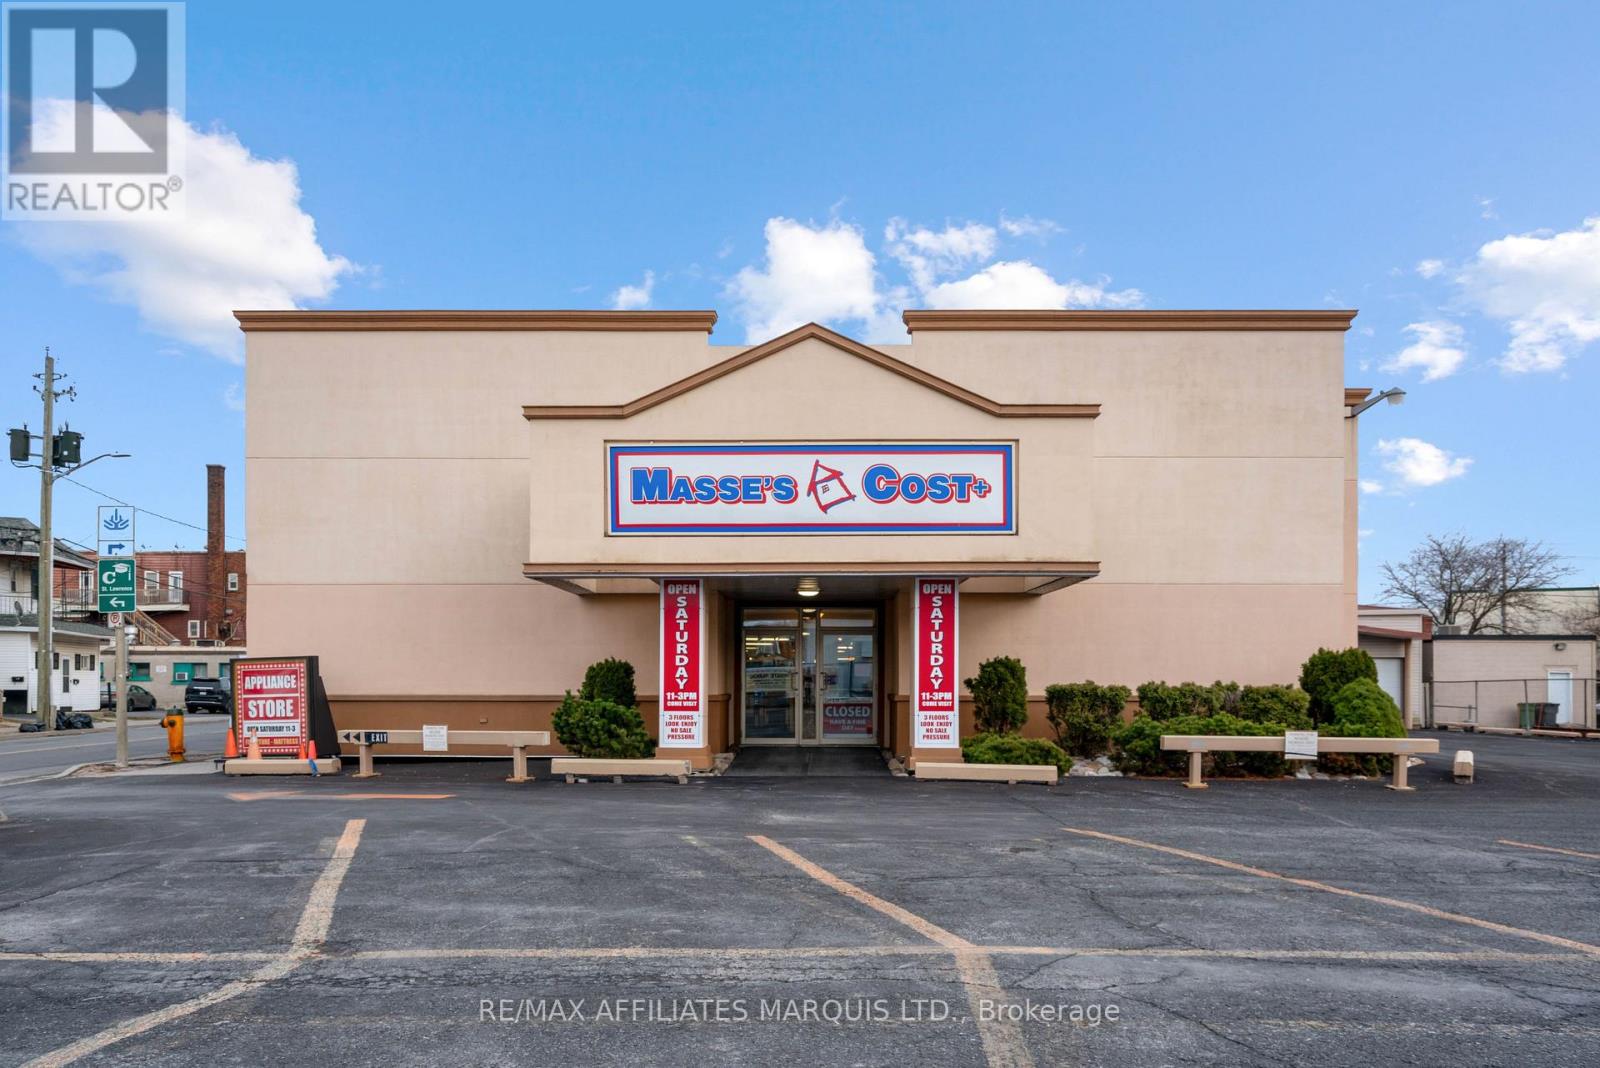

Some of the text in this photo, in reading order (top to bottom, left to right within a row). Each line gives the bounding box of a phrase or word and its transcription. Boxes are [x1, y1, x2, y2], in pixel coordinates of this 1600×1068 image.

[630, 467, 798, 504] MASSE'S
[667, 584, 697, 595] OPEN
[922, 584, 952, 595] OPEN
[675, 596, 689, 690] SATURDAY
[930, 596, 944, 690] SATURDAY
[244, 675, 297, 690] APPLIANCE
[665, 692, 697, 700] 11-3PM
[920, 692, 952, 700] 11-3PM
[248, 699, 294, 718] STORE
[825, 706, 870, 717] CLOSED
[371, 733, 387, 743] EXIT
